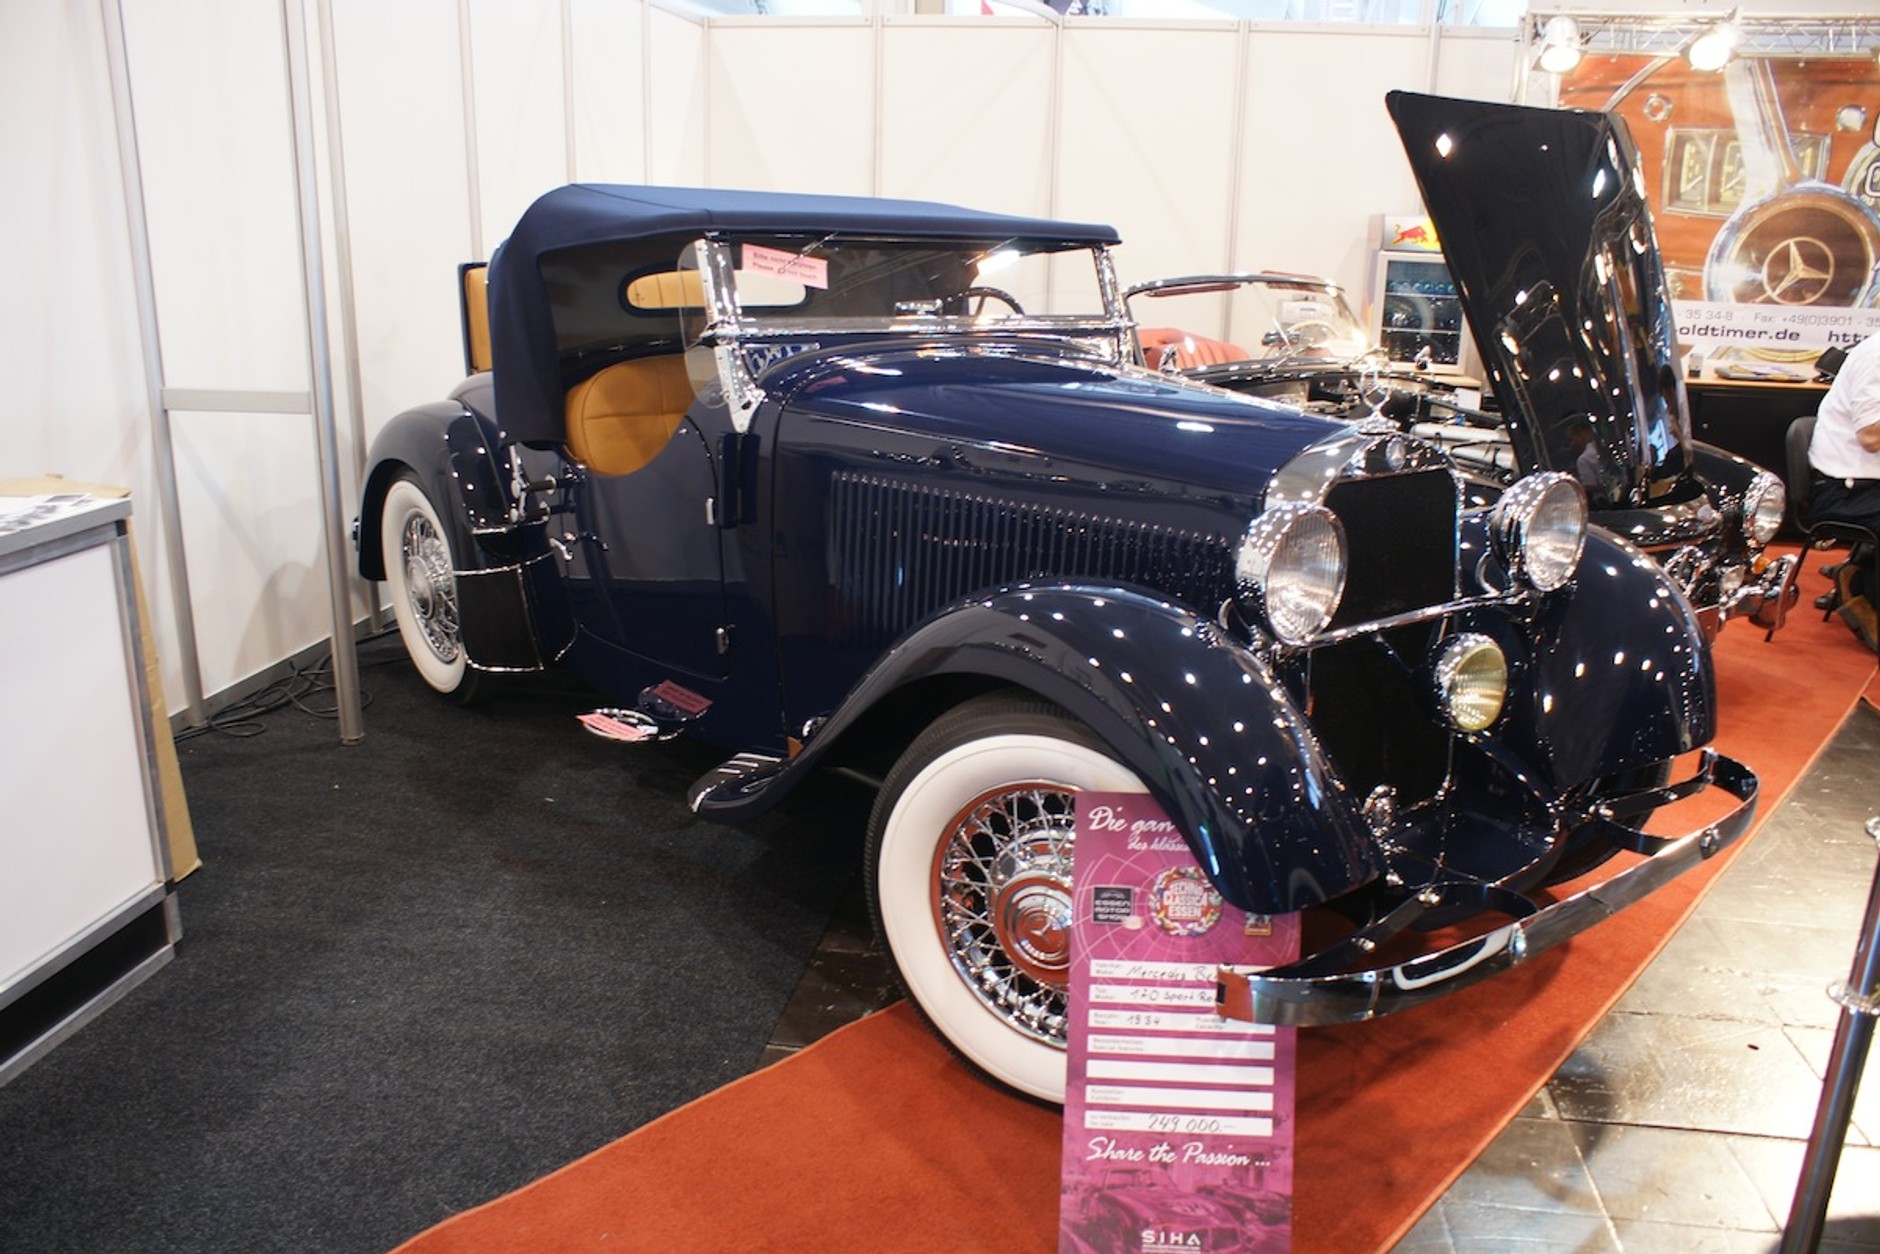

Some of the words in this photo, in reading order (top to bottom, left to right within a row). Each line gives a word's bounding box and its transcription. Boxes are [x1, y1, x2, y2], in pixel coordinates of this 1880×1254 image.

[1685, 309, 1701, 320] 35
[1088, 806, 1128, 832] Die
[1128, 819, 1180, 844] gan
[1168, 905, 1202, 917] ESSEN
[1126, 965, 1186, 981] Mercedes
[1147, 1113, 1181, 1132] 249
[1086, 1136, 1145, 1162] Share
[1148, 1141, 1178, 1163] the
[1182, 1141, 1250, 1167] Passion
[1141, 1230, 1201, 1245] SIHA
